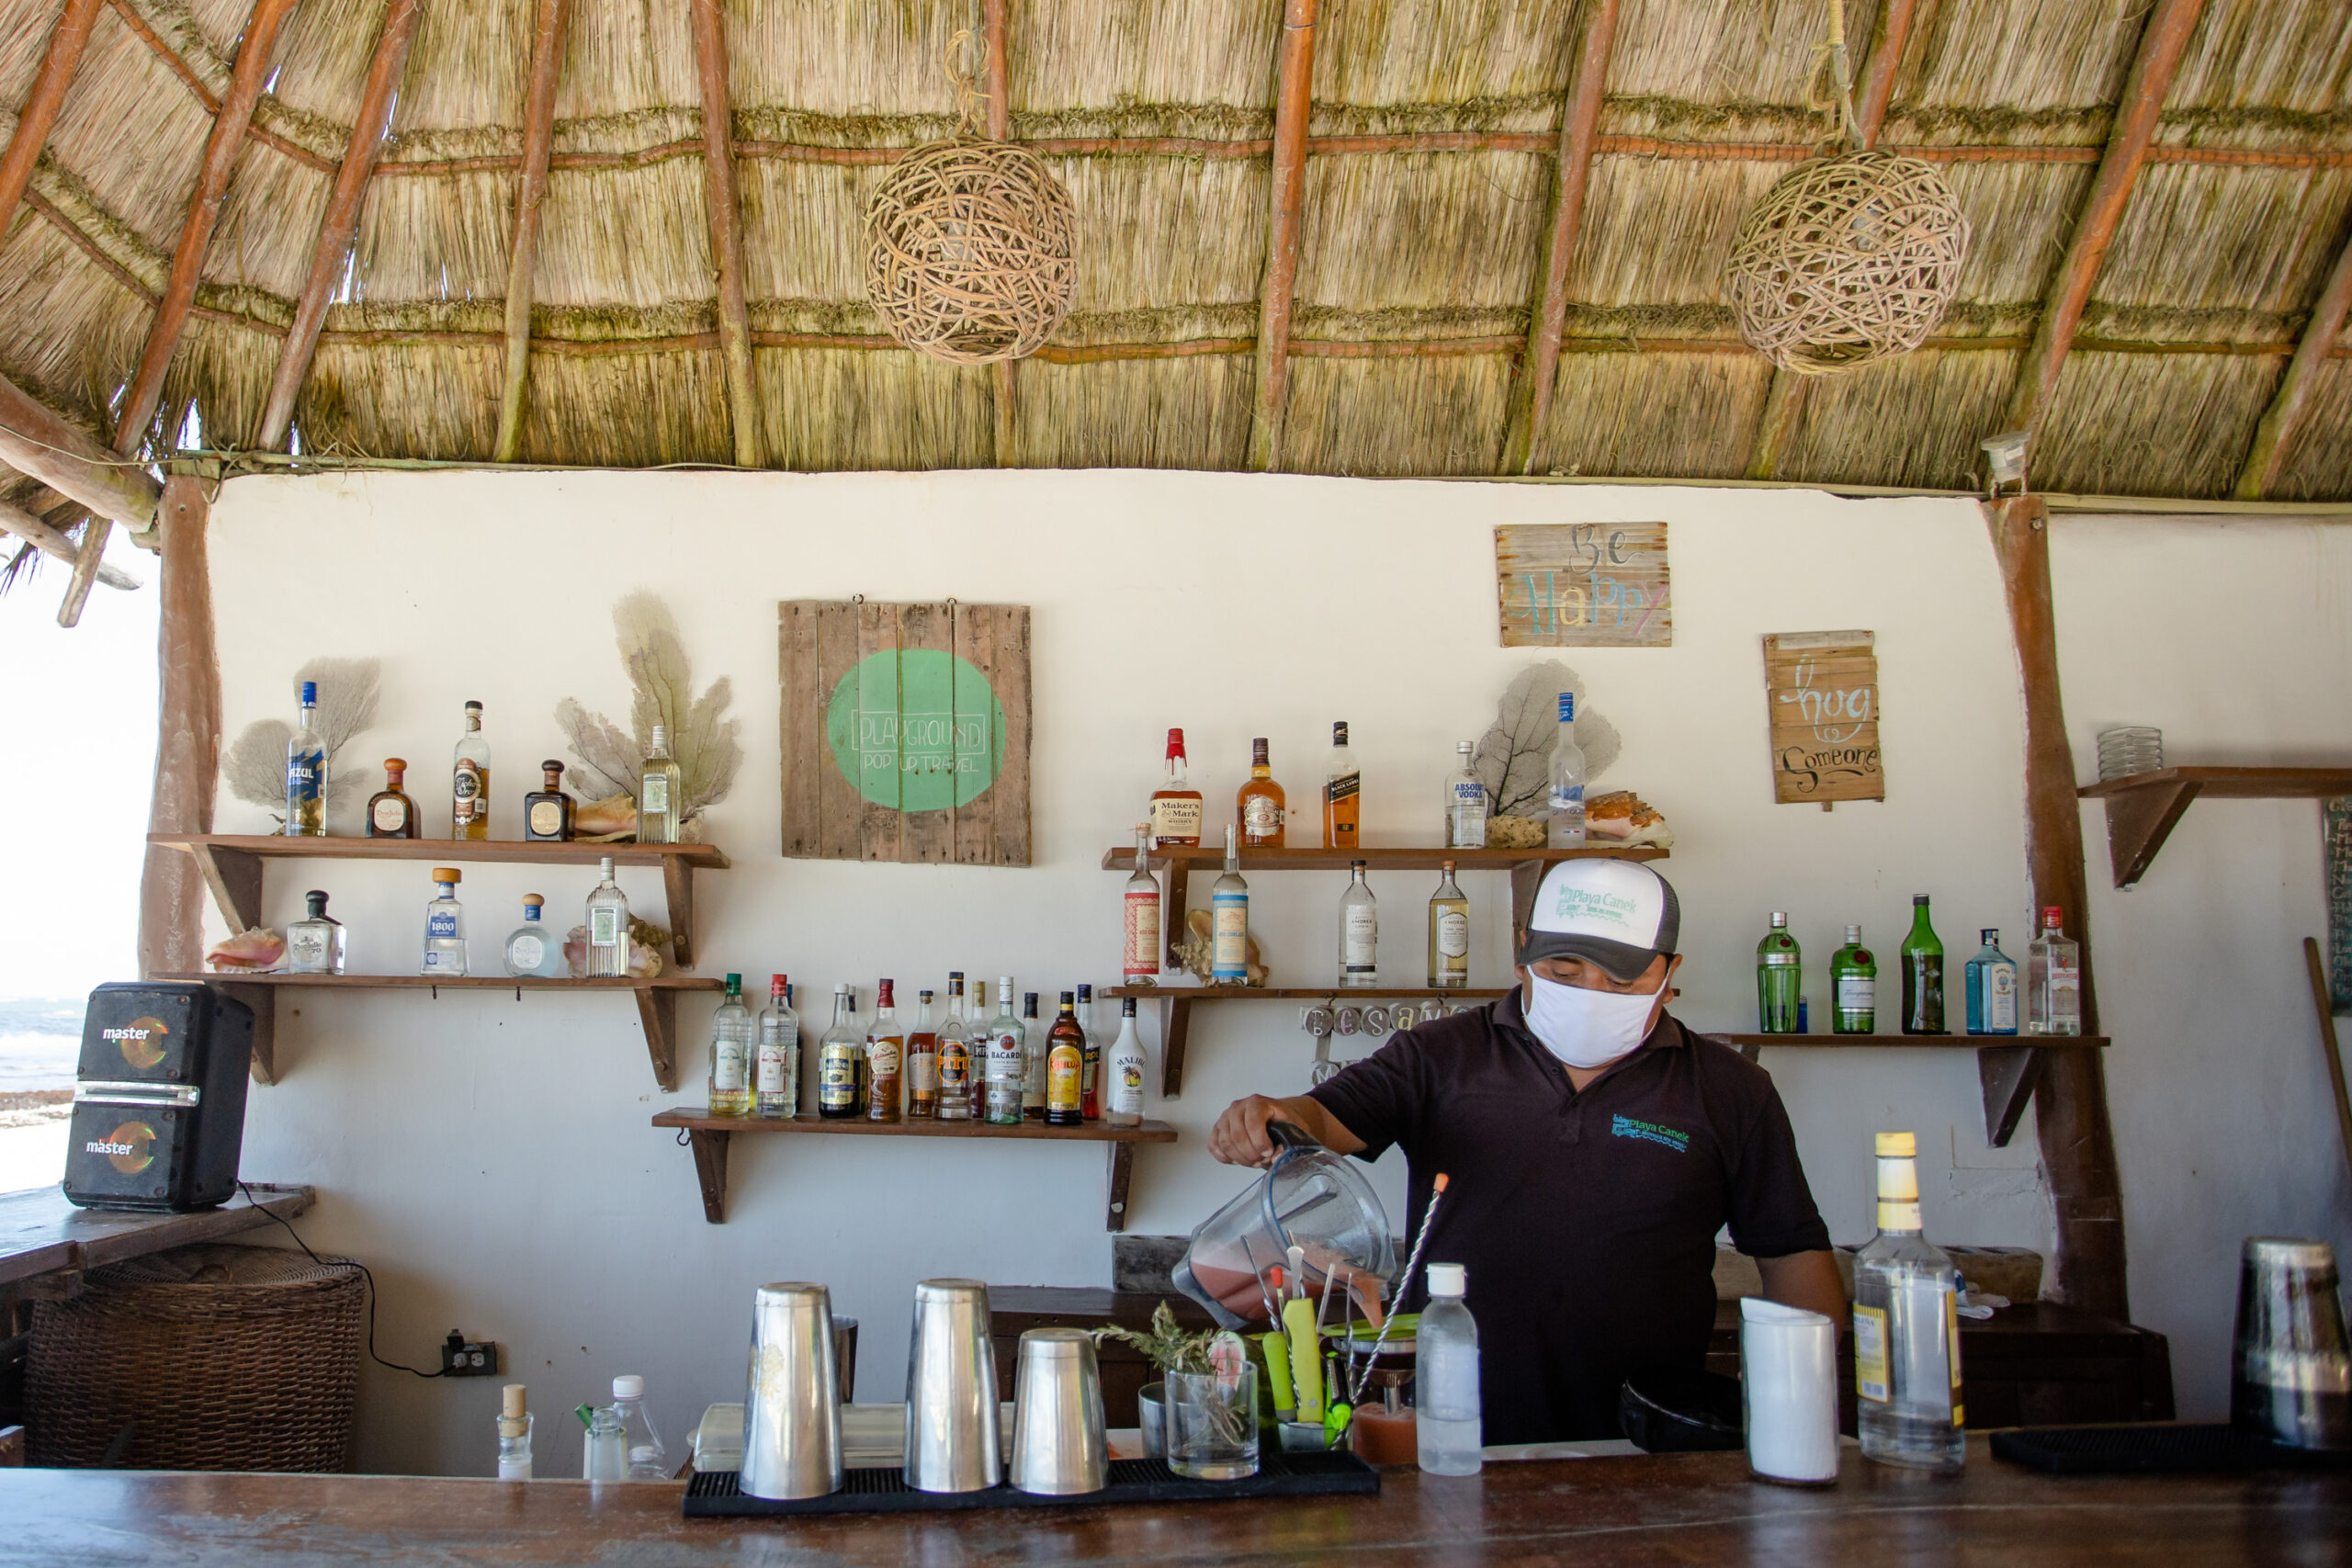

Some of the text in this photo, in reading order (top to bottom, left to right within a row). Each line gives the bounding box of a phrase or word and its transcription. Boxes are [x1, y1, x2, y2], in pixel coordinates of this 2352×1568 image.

[1569, 524, 1645, 575] Be
[1780, 653, 1871, 744] hug
[859, 716, 981, 749] PLAYGROUND
[288, 767, 314, 779] AZUL
[864, 753, 892, 770] POP
[920, 755, 980, 773] TRAVEL
[1782, 746, 1878, 794] Someone
[1572, 888, 1601, 906] Playa
[1602, 893, 1638, 914] Canek
[431, 921, 455, 931] 1800
[102, 1028, 151, 1040] master
[1629, 1119, 1657, 1133] Playa
[1657, 1124, 1690, 1144] Canek
[85, 1141, 134, 1156] master
